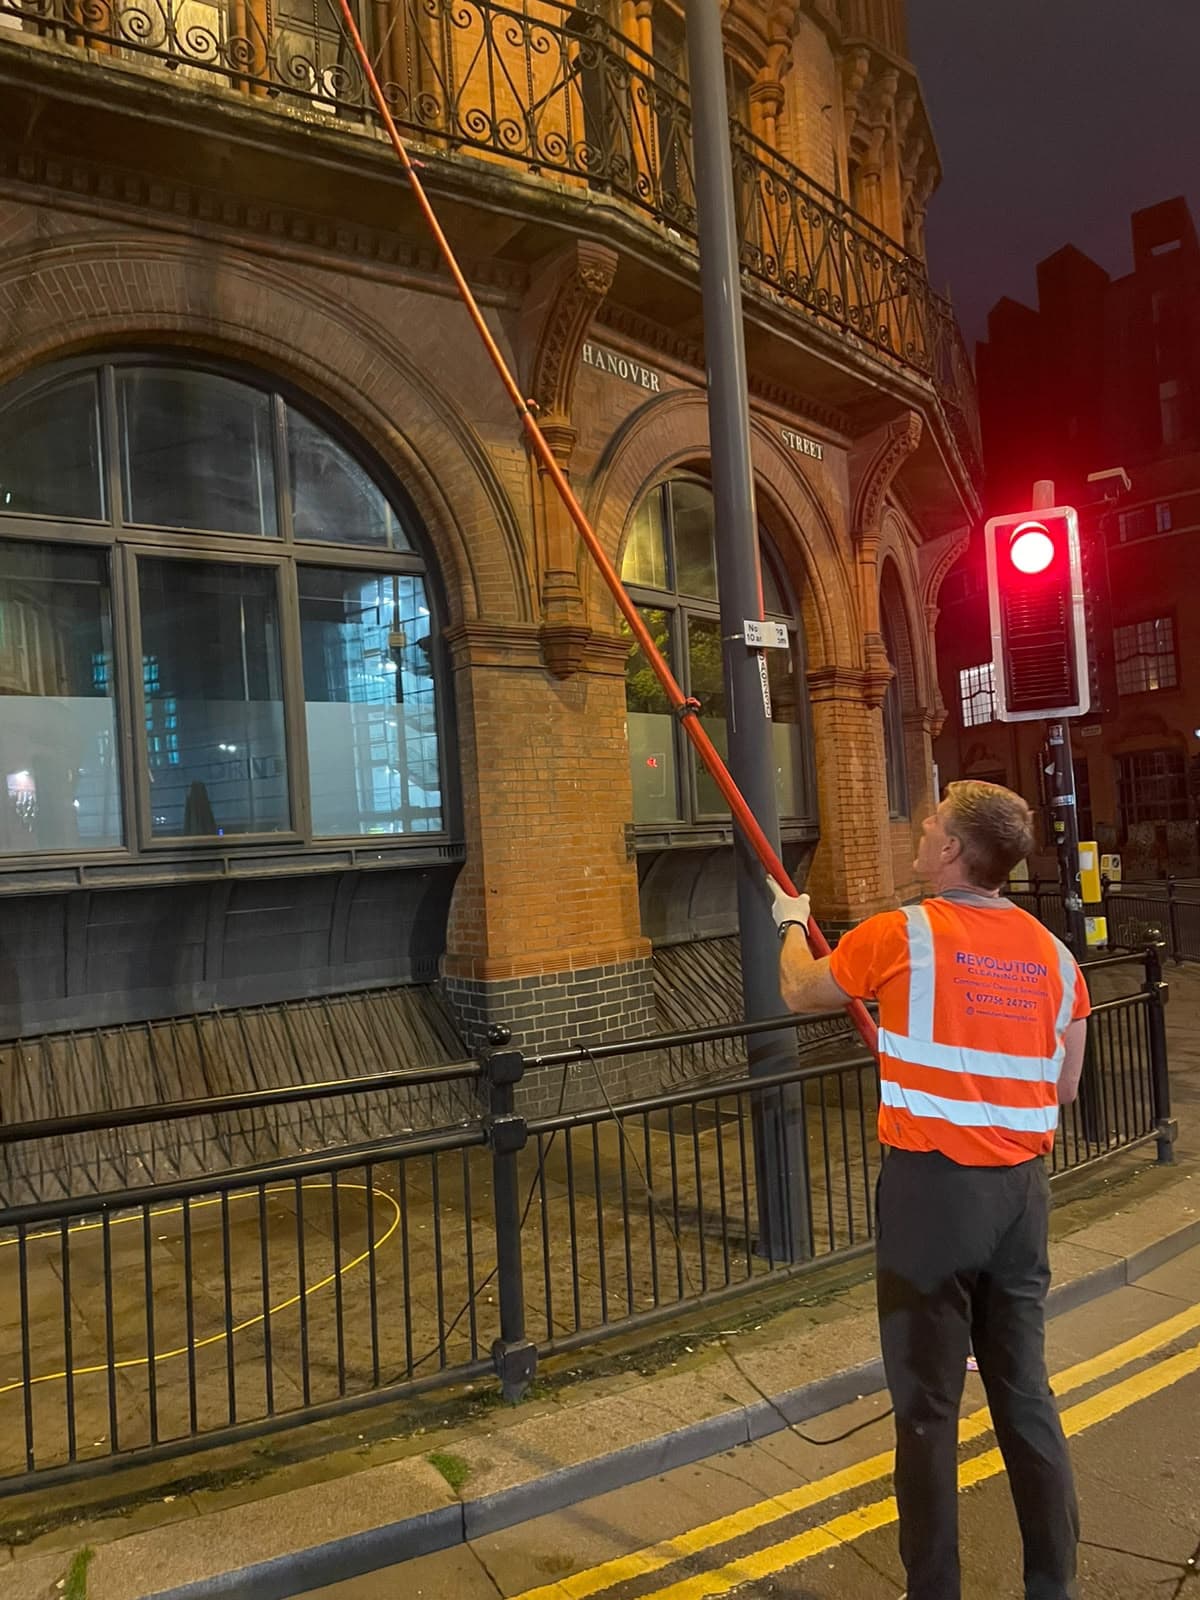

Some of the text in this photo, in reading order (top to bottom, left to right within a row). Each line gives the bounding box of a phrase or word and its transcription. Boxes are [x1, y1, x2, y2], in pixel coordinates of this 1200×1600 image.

[582, 343, 823, 461] HANOVER STREET
[956, 952, 1047, 976] REVOLUTION
[968, 967, 1039, 984] CLEANING LTD
